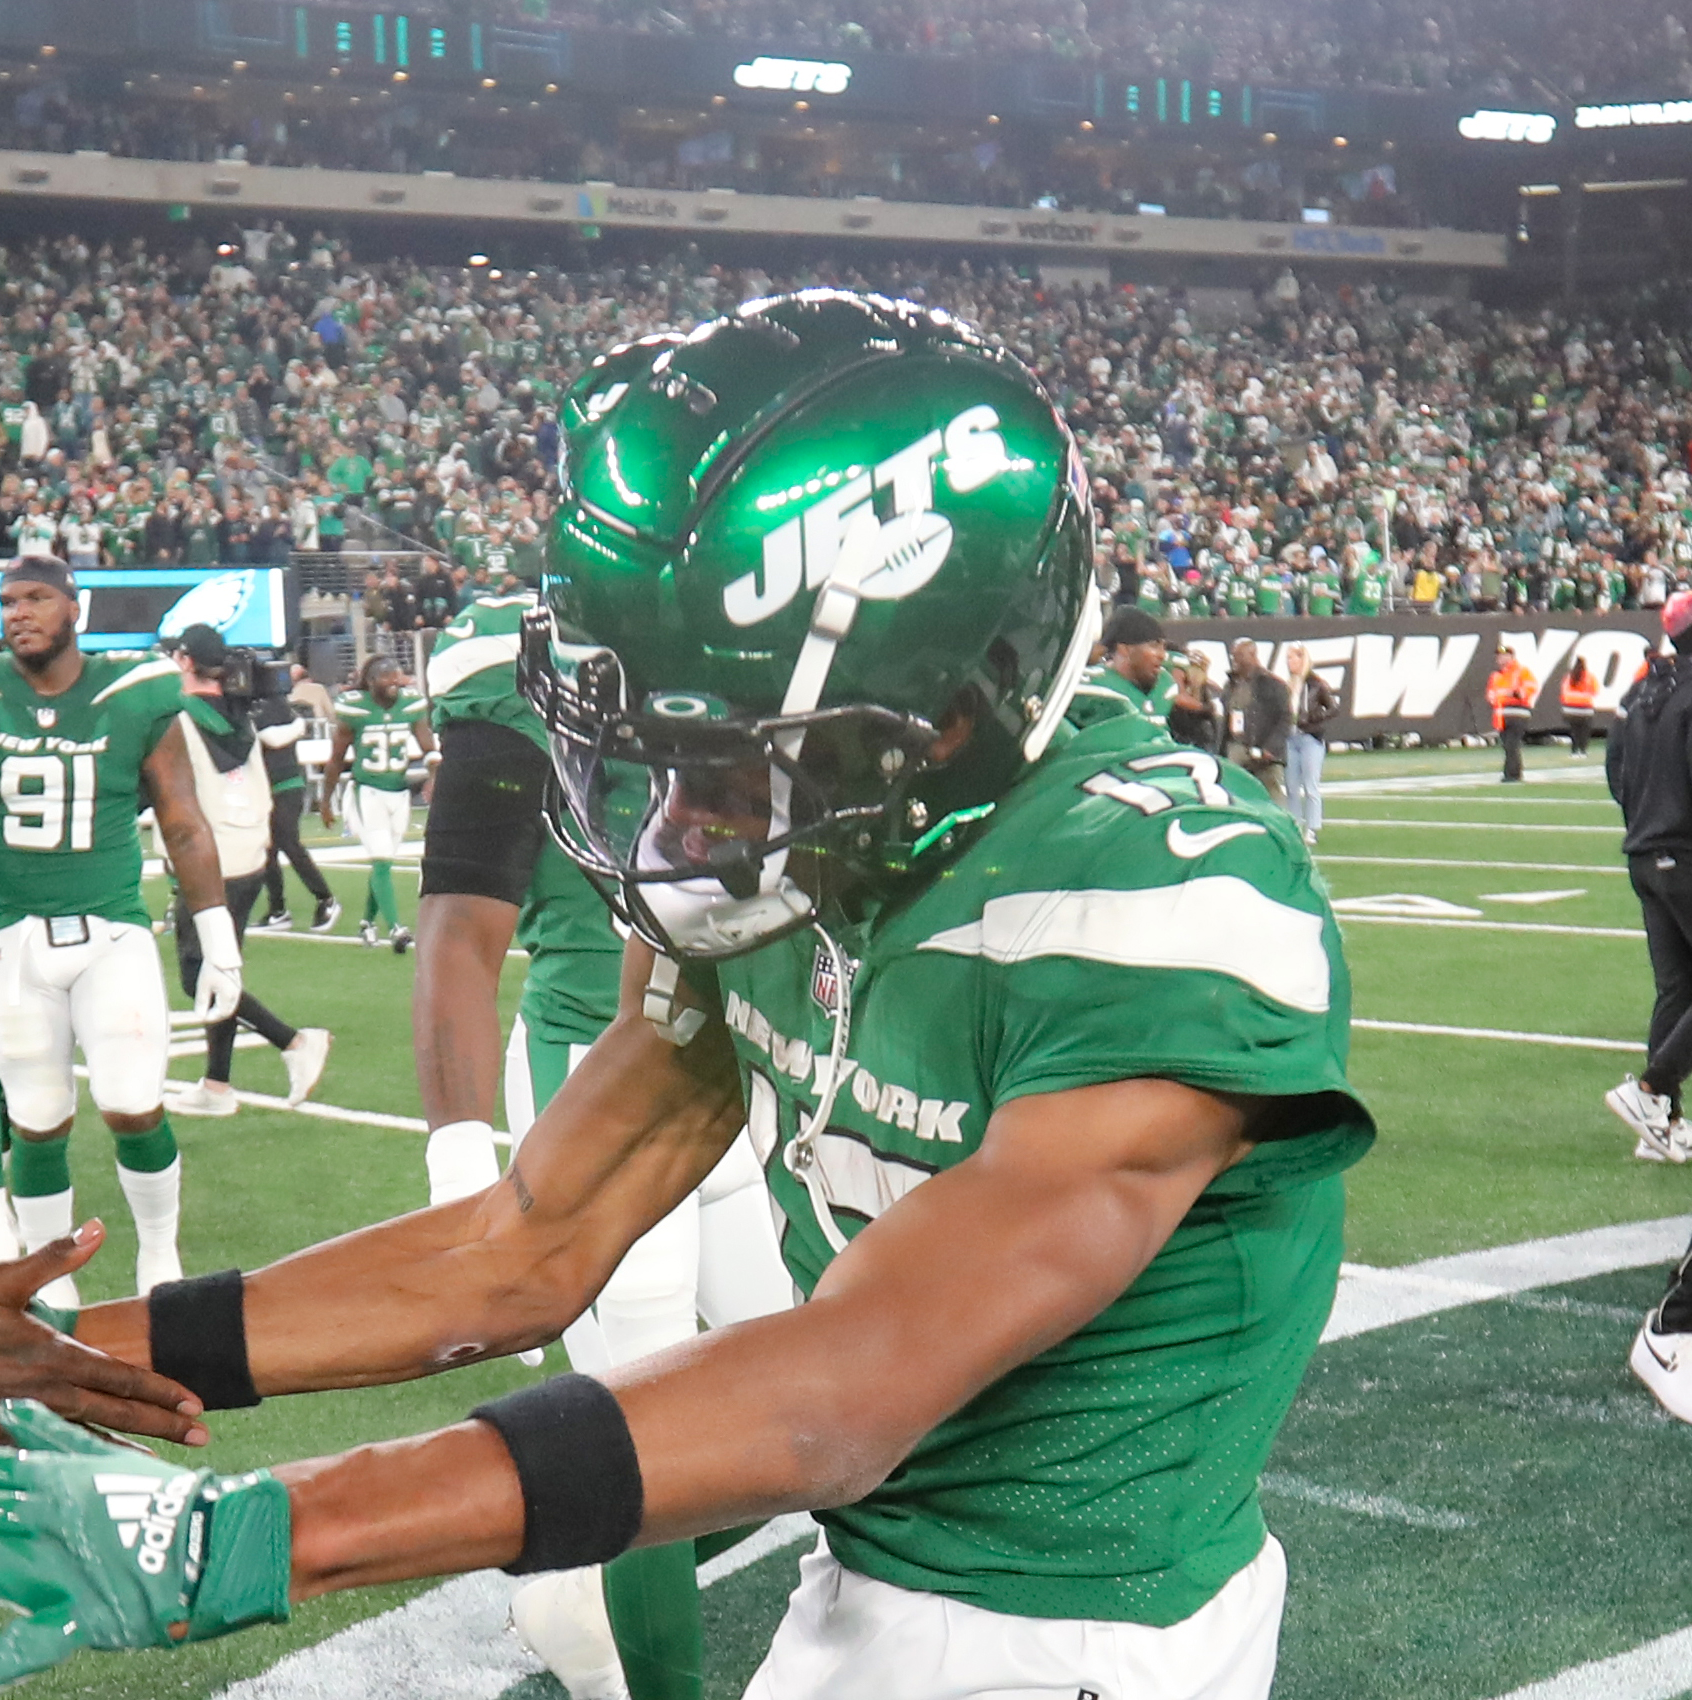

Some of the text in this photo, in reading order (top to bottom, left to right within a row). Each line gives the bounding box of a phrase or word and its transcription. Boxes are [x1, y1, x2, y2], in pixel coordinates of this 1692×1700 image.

[733, 56, 852, 93] JETS
[1458, 109, 1558, 143] JETS
[1017, 219, 1092, 241] verizon
[722, 403, 1007, 628] JETS
[44, 735, 108, 756] YORK
[361, 729, 410, 773] 33
[0, 754, 95, 850] 91
[724, 989, 812, 1085] NEW
[810, 1054, 970, 1143] YORK
